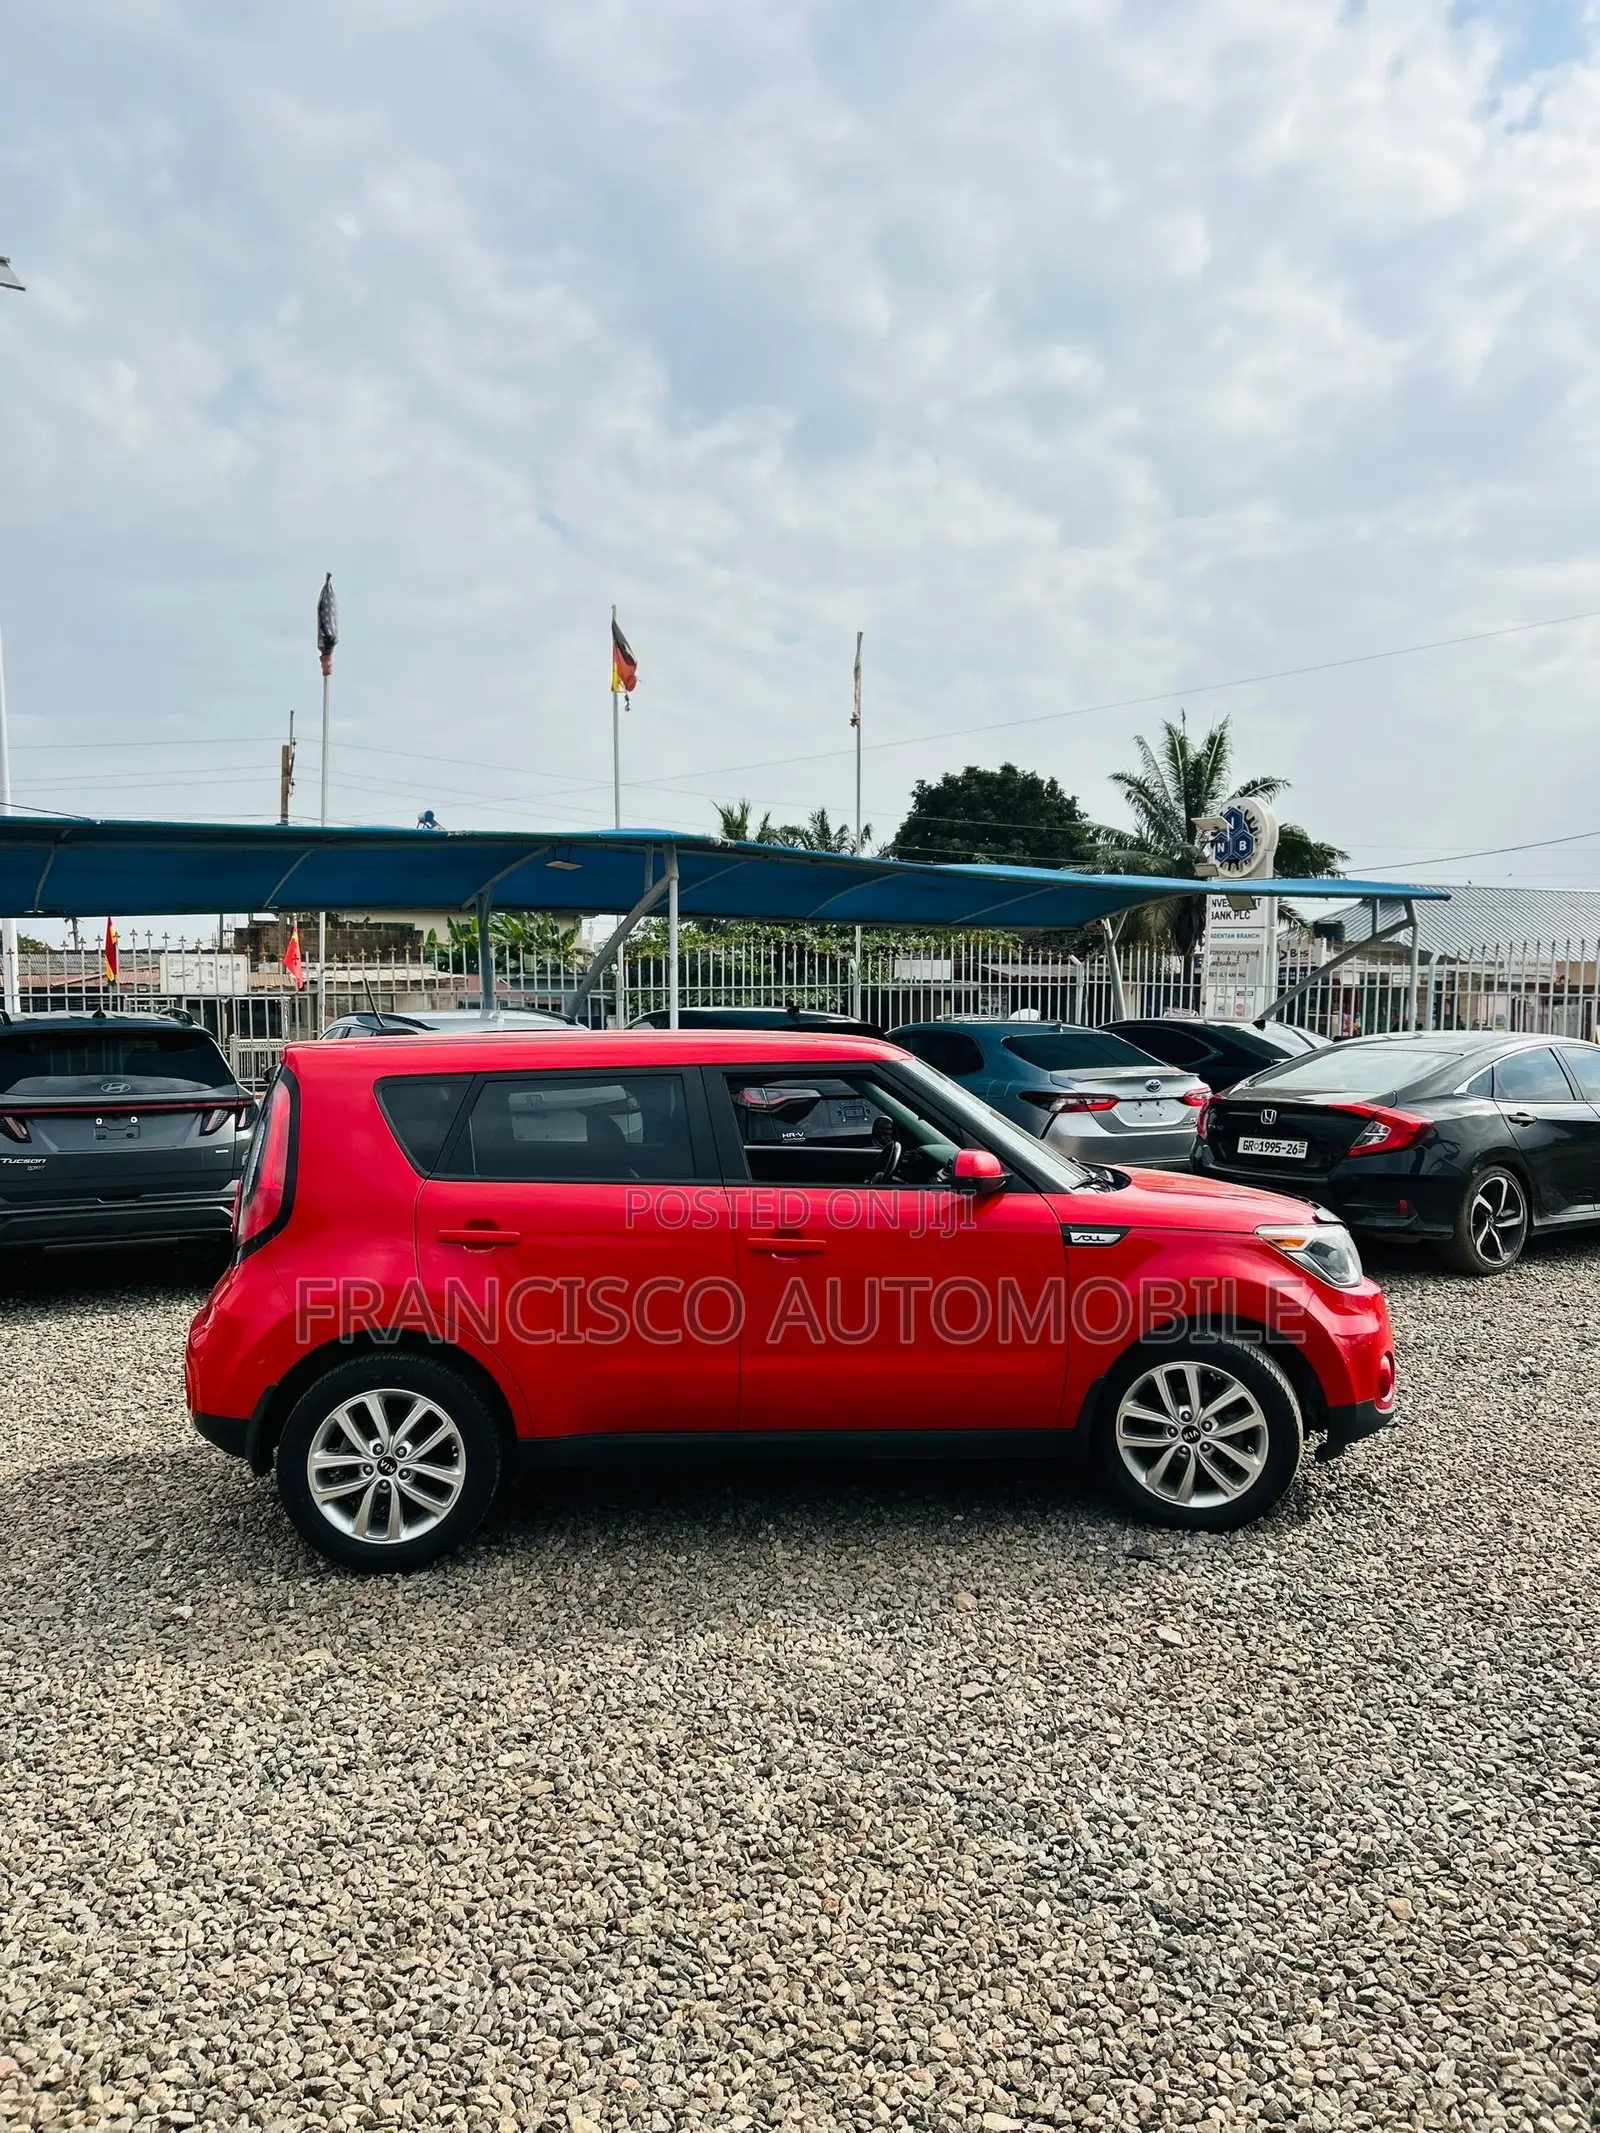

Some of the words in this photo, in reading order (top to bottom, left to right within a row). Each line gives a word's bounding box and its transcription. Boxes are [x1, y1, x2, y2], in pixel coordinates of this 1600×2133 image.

[1234, 910, 1251, 920] PLC
[1243, 1140, 1254, 1151] GR
[1259, 1141, 1298, 1155] 1995-26
[1183, 1430, 1199, 1440] KIA
